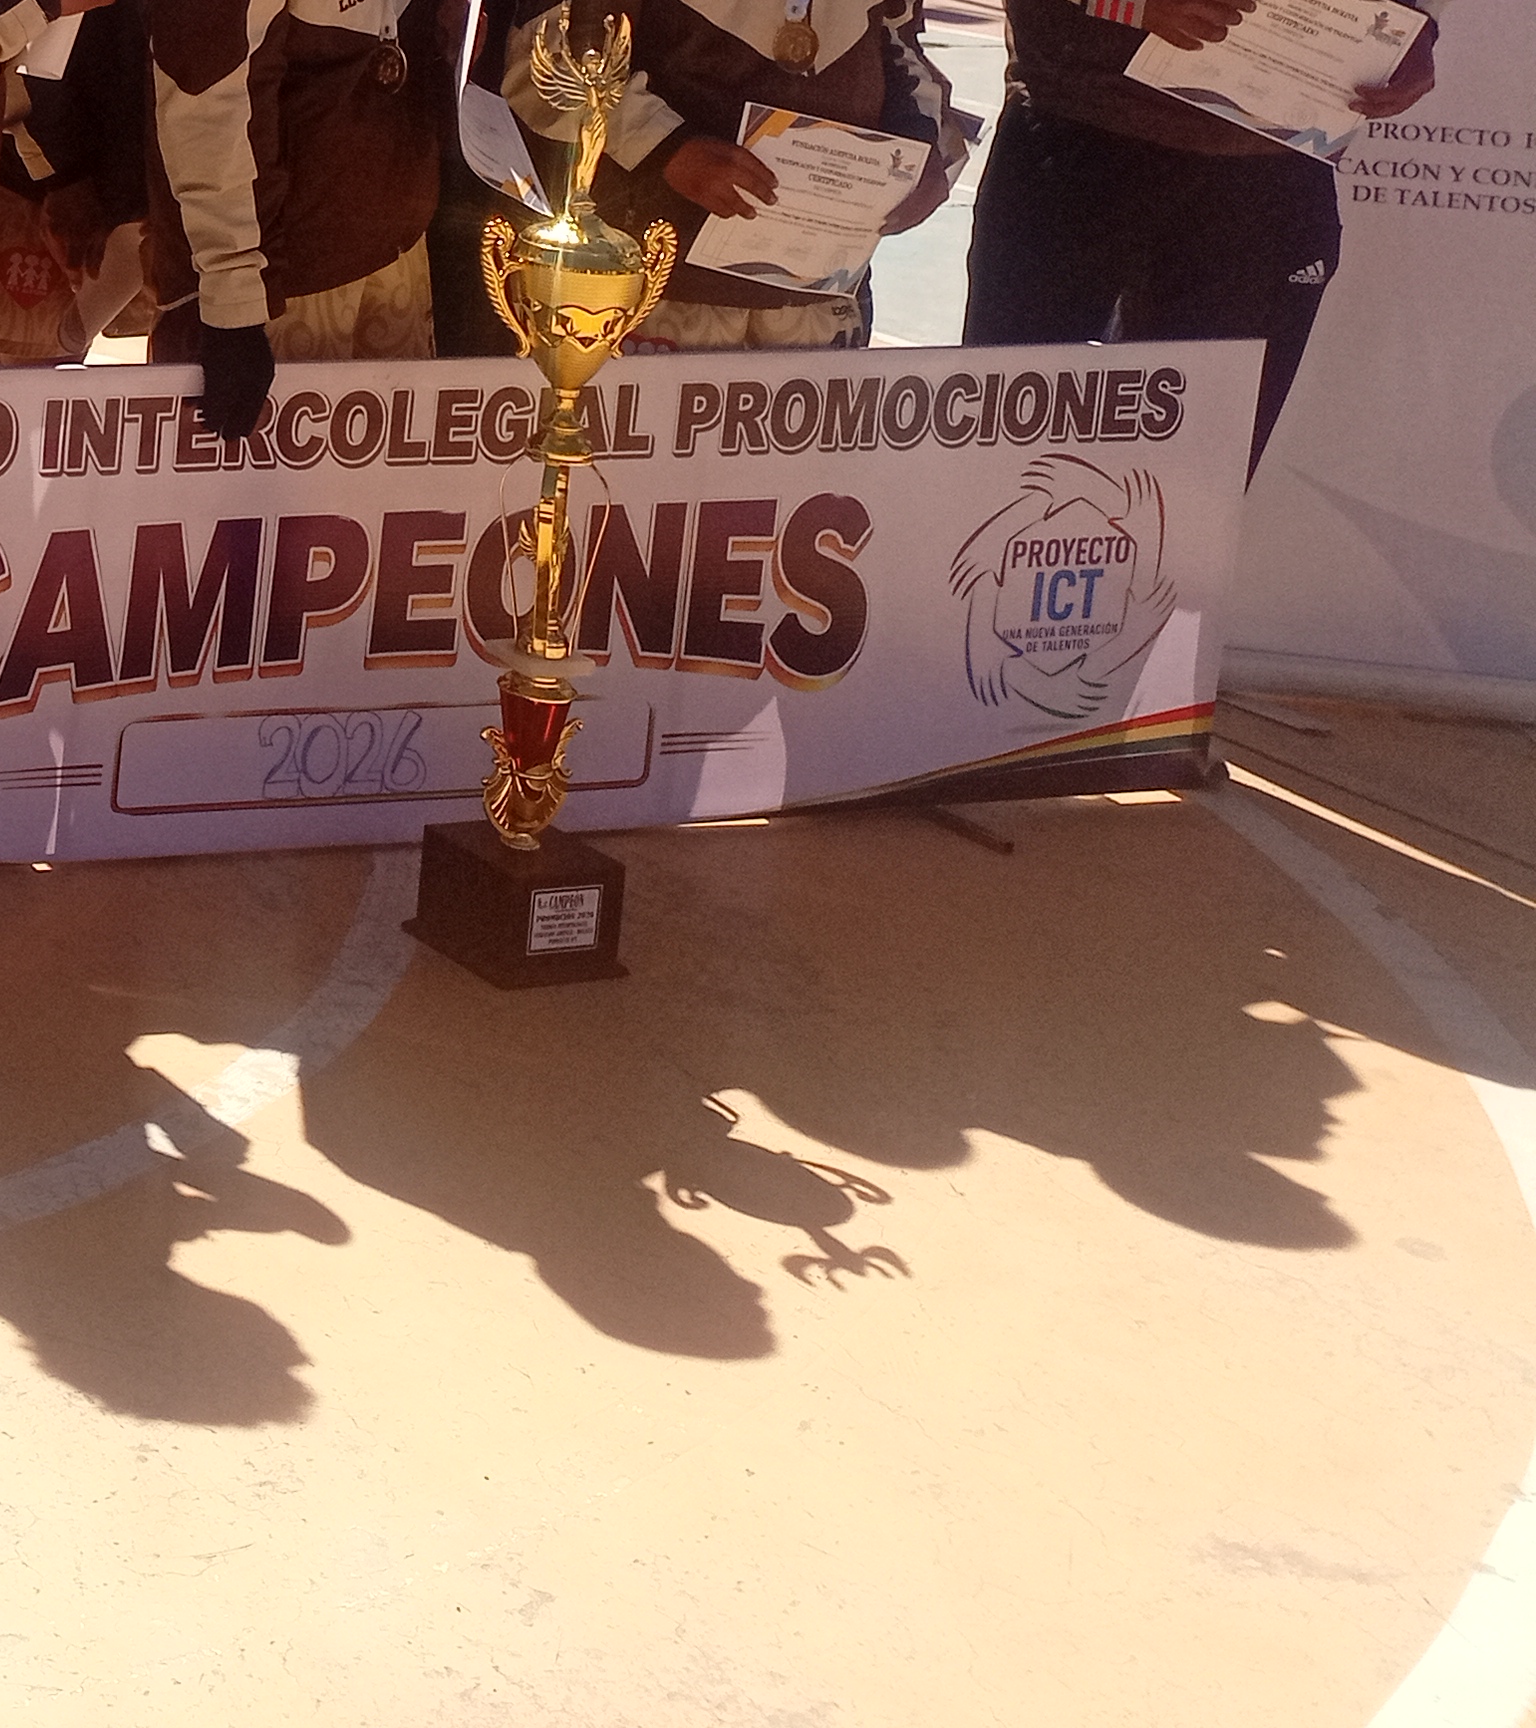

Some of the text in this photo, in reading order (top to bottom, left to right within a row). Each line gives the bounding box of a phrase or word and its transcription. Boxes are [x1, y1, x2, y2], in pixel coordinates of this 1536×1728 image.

[1367, 121, 1512, 149] PROYECTO
[1449, 165, 1466, 183] Y
[1352, 184, 1536, 215] DE TALENTOS
[672, 365, 1187, 458] PROMOCIONES
[1011, 535, 1131, 569] PROYECTO
[1030, 568, 1105, 622] ICT
[1002, 621, 1119, 640] UNA NUEVA GENERACIÓN
[1025, 638, 1090, 653] DE TALENTOS
[258, 709, 427, 798] 2026
